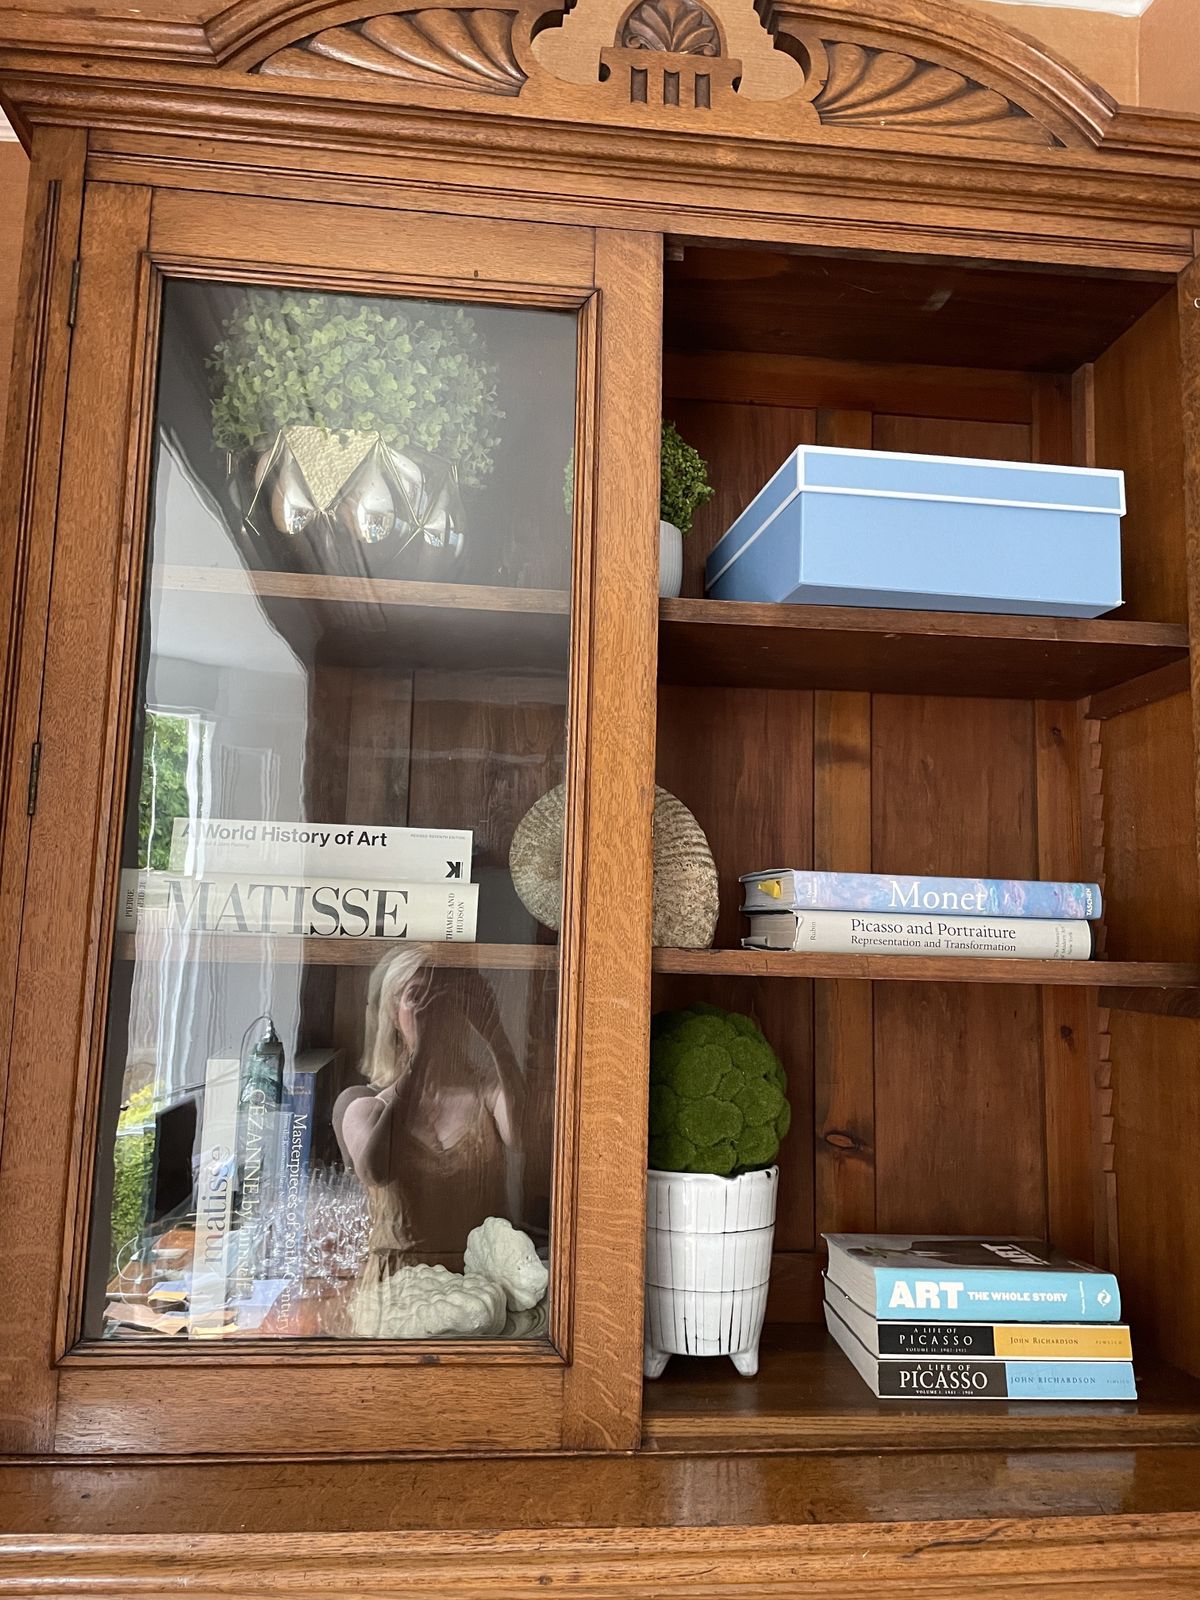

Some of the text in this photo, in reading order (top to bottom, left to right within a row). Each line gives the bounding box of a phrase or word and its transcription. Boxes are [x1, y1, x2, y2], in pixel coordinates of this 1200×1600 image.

[203, 823, 256, 842] World
[261, 826, 331, 847] History
[334, 830, 354, 846] of
[356, 830, 388, 848] Art
[124, 888, 135, 919] PIERRE
[160, 878, 409, 939] MATISSE
[888, 880, 986, 911] Monet
[446, 892, 455, 940] THAMES AND
[456, 901, 465, 934] HUDSON
[850, 918, 1016, 940] Picasso and Portraiture
[809, 921, 817, 941] Rubin
[850, 936, 1016, 952] Representation and Transformation
[242, 1089, 267, 1194] CÉZANNE
[286, 1114, 308, 1209] Masterpieces
[201, 1144, 230, 1264] matisse
[234, 1199, 260, 1219] by
[286, 1212, 301, 1228] of
[277, 1272, 297, 1332] Century
[888, 1280, 1068, 1309] ART THE WHOLE STORY
[899, 1334, 973, 1346] PICASSO
[1010, 1336, 1079, 1345] JOHN RICHARDSON
[899, 1371, 988, 1389] PICASSO
[1010, 1376, 1096, 1384] JOHN RICHARDSON
